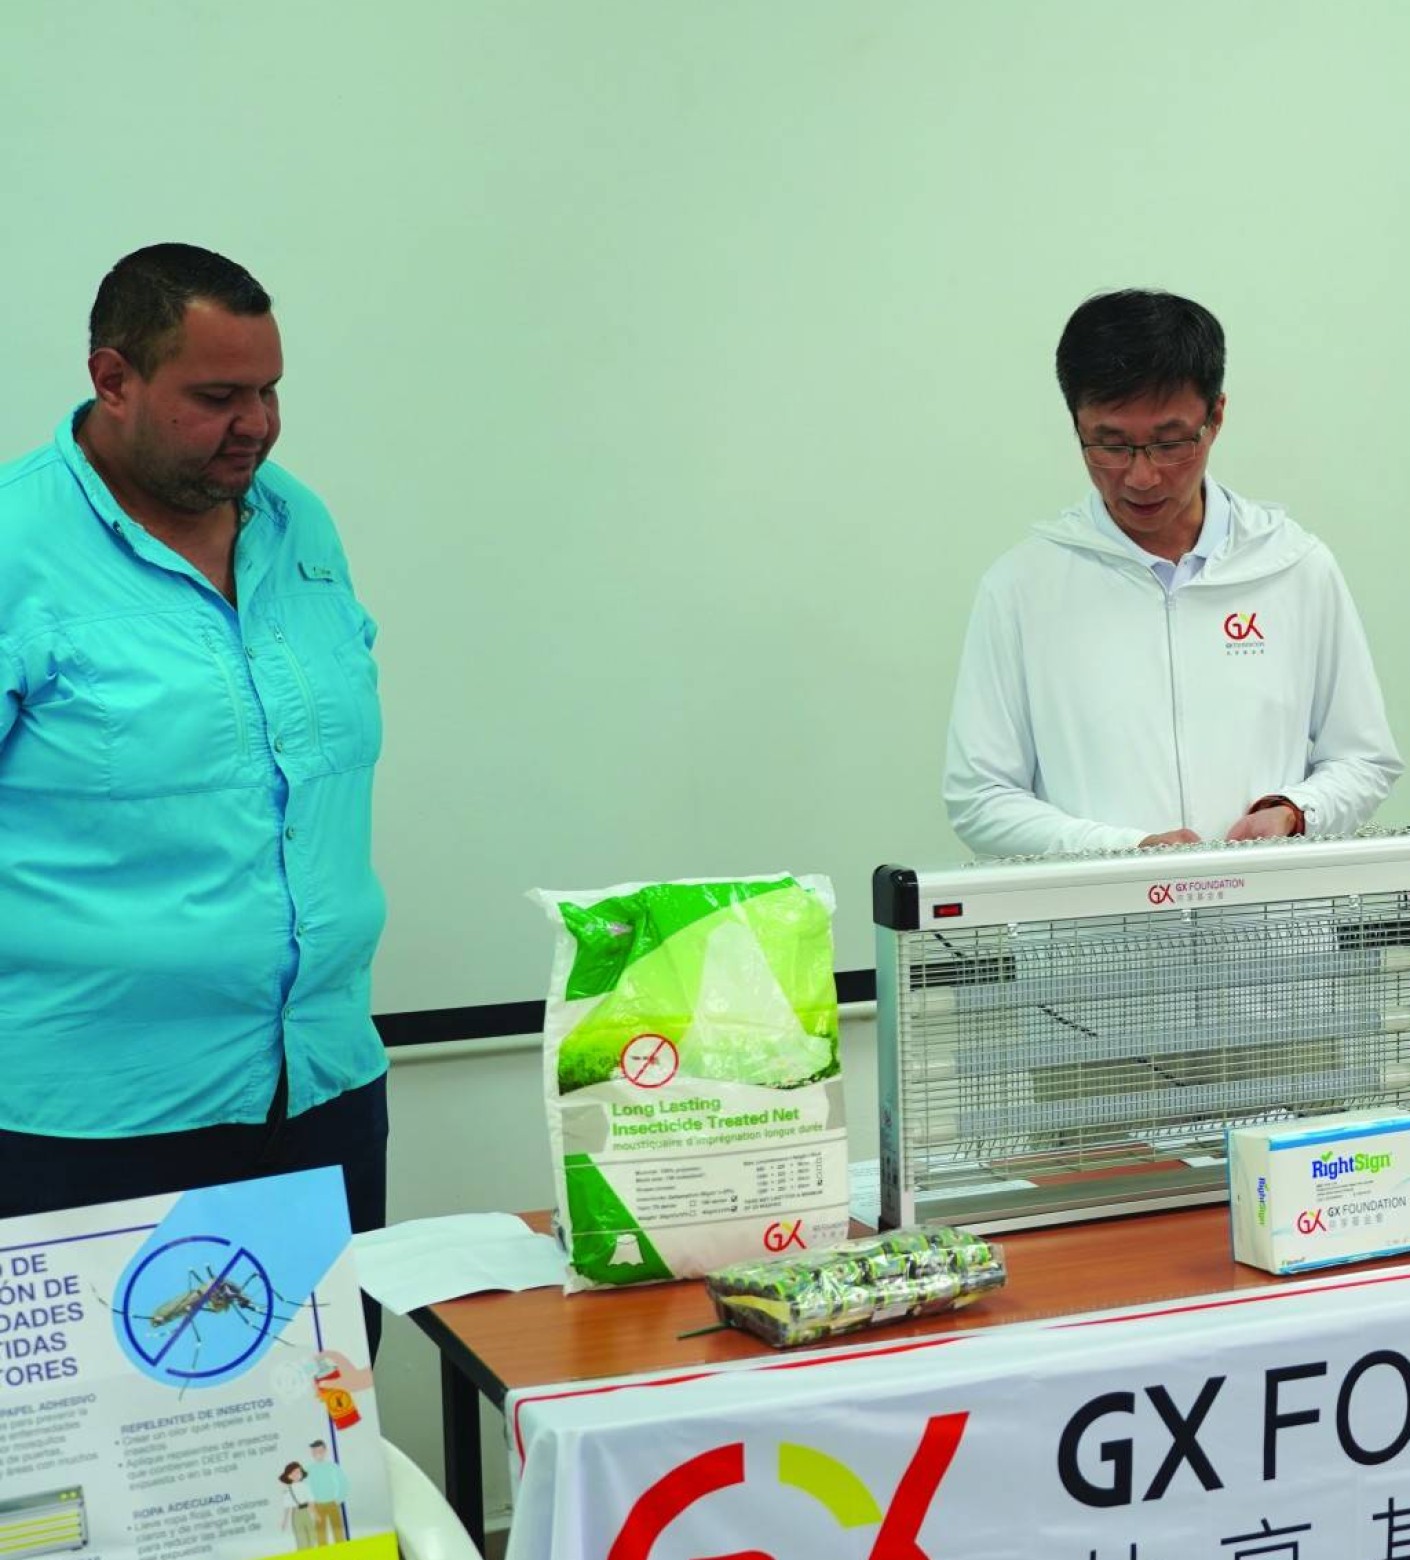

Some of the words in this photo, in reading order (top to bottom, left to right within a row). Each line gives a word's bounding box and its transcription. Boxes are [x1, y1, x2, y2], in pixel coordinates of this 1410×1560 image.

[1189, 879, 1245, 891] FOUNDATION
[612, 1101, 655, 1117] Long
[659, 1097, 721, 1114] Lasting
[612, 1117, 703, 1136] Insecticide
[707, 1110, 768, 1129] Treated
[772, 1107, 800, 1122] Net
[764, 1127, 796, 1140] longue
[1311, 1151, 1391, 1180] RightSign
[1327, 1206, 1341, 1217] GX
[1342, 1196, 1407, 1214] FOUNDATION
[764, 1219, 807, 1252] GX
[12, 1253, 48, 1277] DE
[0, 1280, 36, 1306] ÓN
[44, 1275, 81, 1298] DE
[0, 1302, 84, 1334] DADES
[120, 1413, 195, 1434] REPELENTES
[198, 1408, 213, 1420] DE
[216, 1398, 274, 1417] INSECTOS
[1057, 1375, 1227, 1508] GX
[132, 1506, 164, 1520] ROPA
[168, 1493, 232, 1514] ADECUADA
